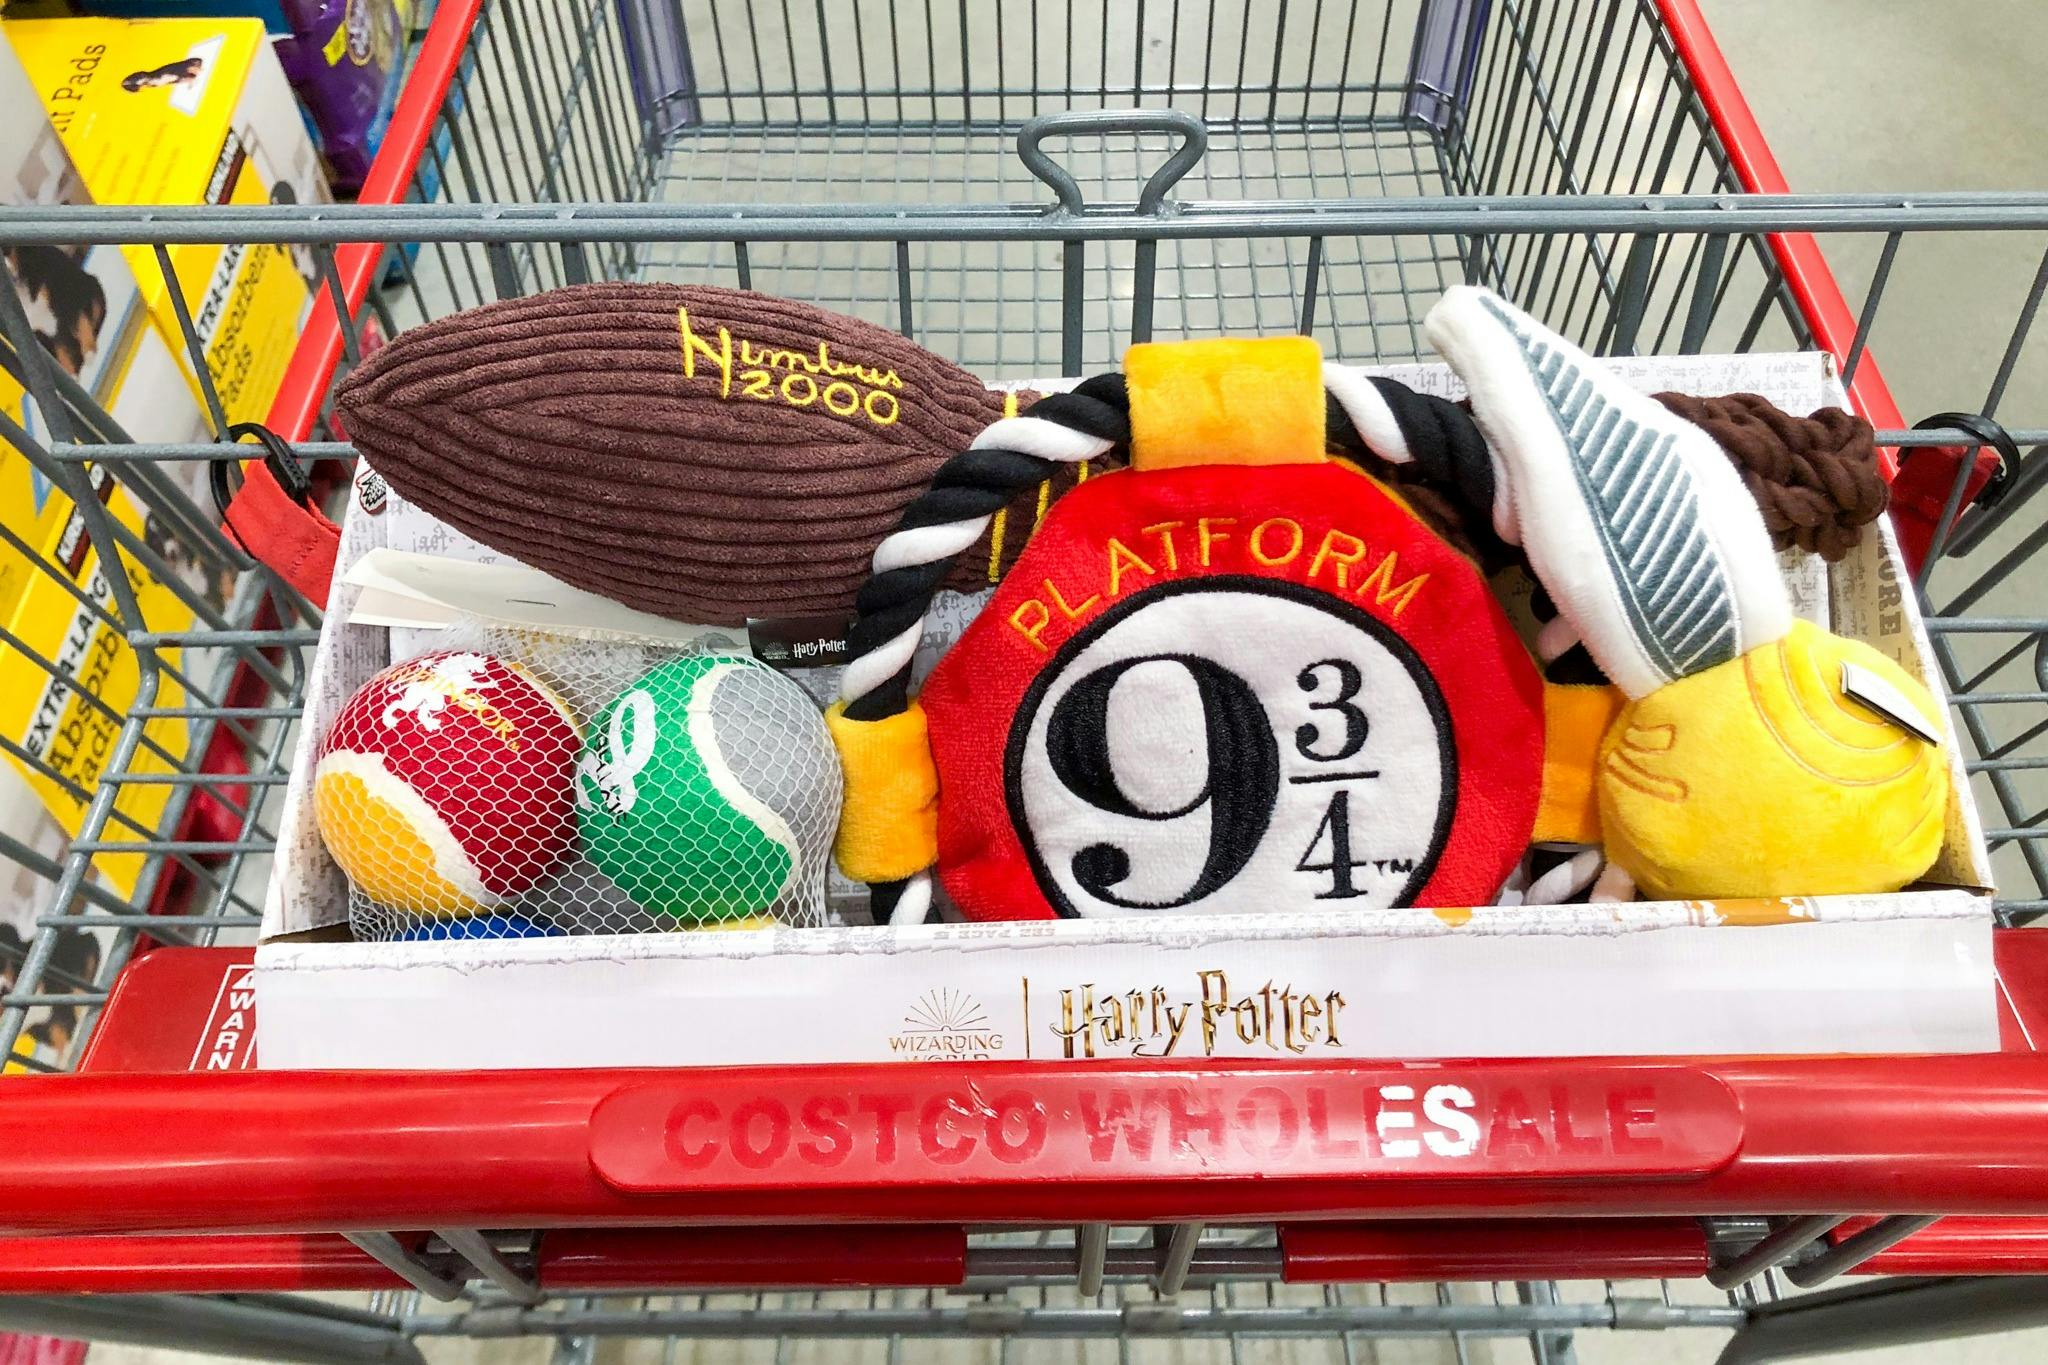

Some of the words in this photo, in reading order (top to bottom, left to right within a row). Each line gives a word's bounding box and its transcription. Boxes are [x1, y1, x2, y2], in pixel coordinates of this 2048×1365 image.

[51, 44, 107, 101] Pads
[678, 306, 903, 400] Nimbus
[739, 370, 900, 426] 2000
[1010, 516, 1432, 653] PLATFORM
[27, 573, 108, 758] EXTRA-LAG
[792, 642, 818, 658] Harry
[818, 638, 847, 655] Potter
[1045, 652, 1280, 910] 9
[888, 1034, 1003, 1054] WIZARDING
[1049, 983, 1194, 1058] Harry
[1196, 969, 1347, 1057] Potter
[663, 1089, 1048, 1170] COSTCO
[1078, 1083, 1664, 1164] WHOLESALE
